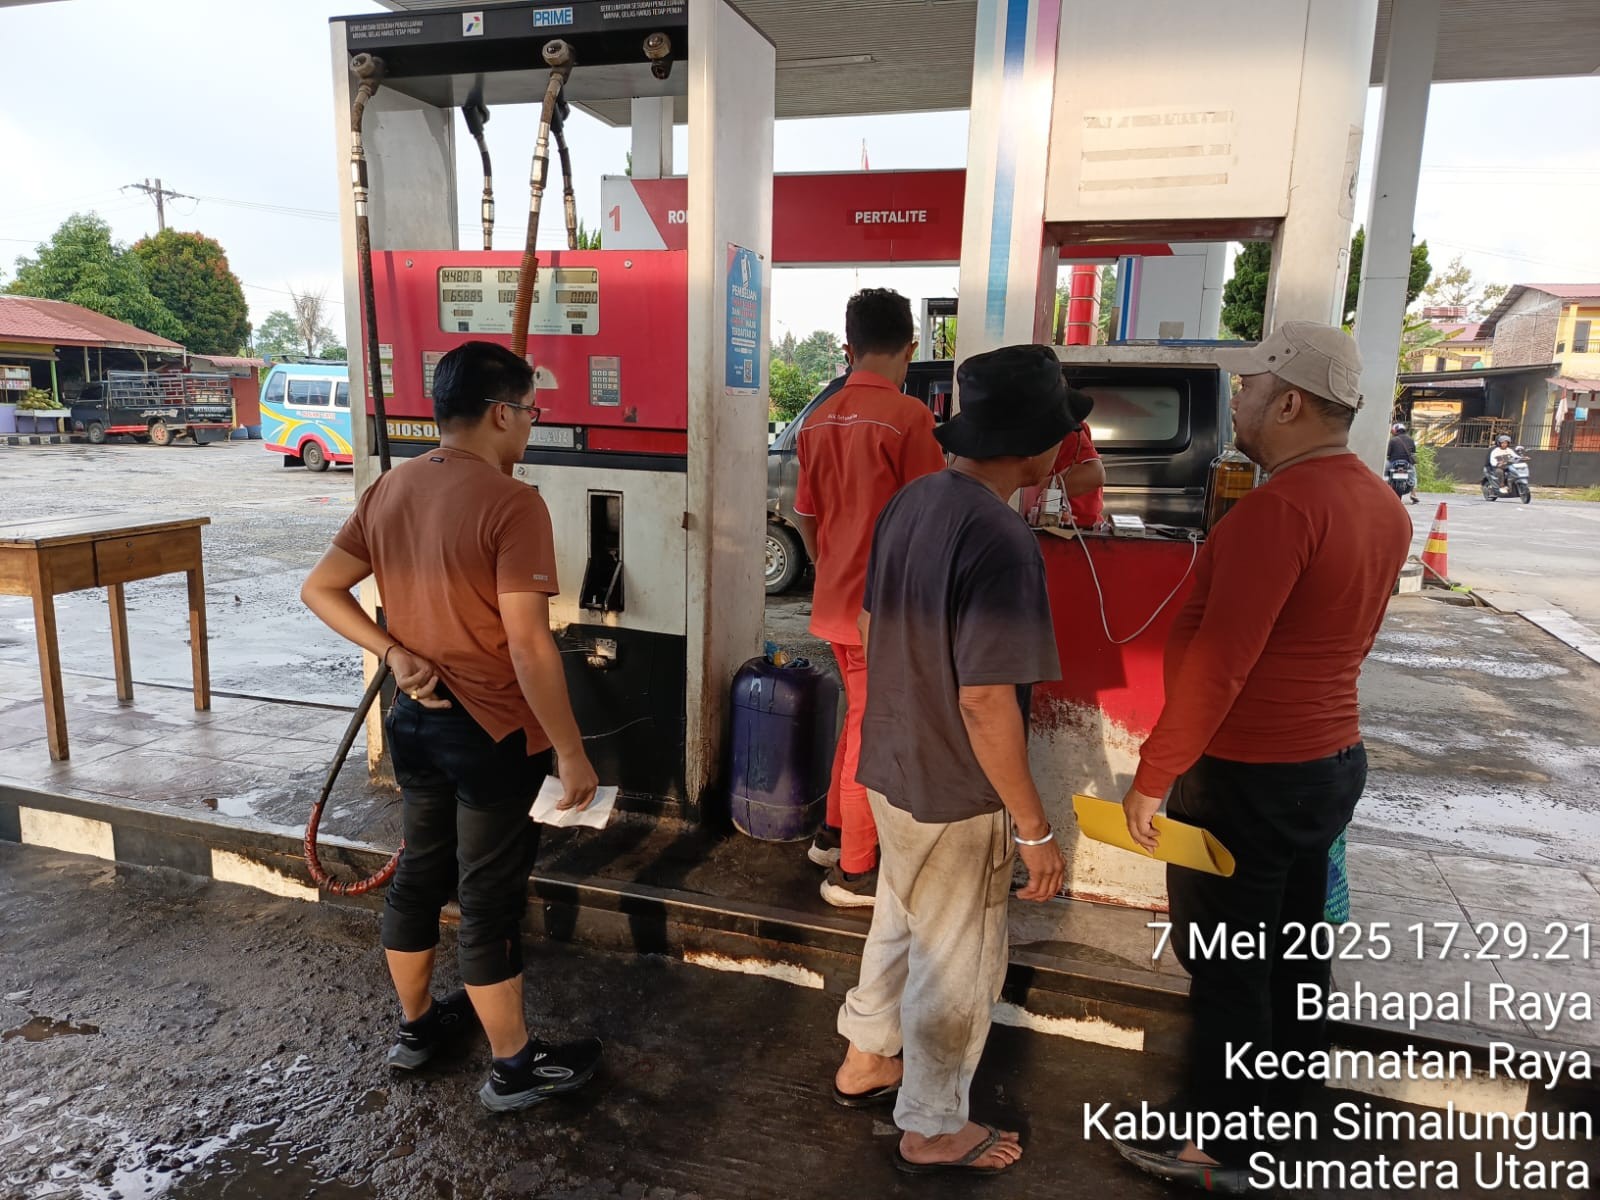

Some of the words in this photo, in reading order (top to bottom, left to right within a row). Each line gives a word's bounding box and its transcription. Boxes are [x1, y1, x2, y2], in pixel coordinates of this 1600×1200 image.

[534, 9, 572, 25] PRIME
[608, 205, 621, 232] 1
[668, 210, 688, 224] RO
[855, 209, 927, 224] PERTALITE
[591, 271, 598, 283] 0
[387, 423, 440, 438] BIOSOL
